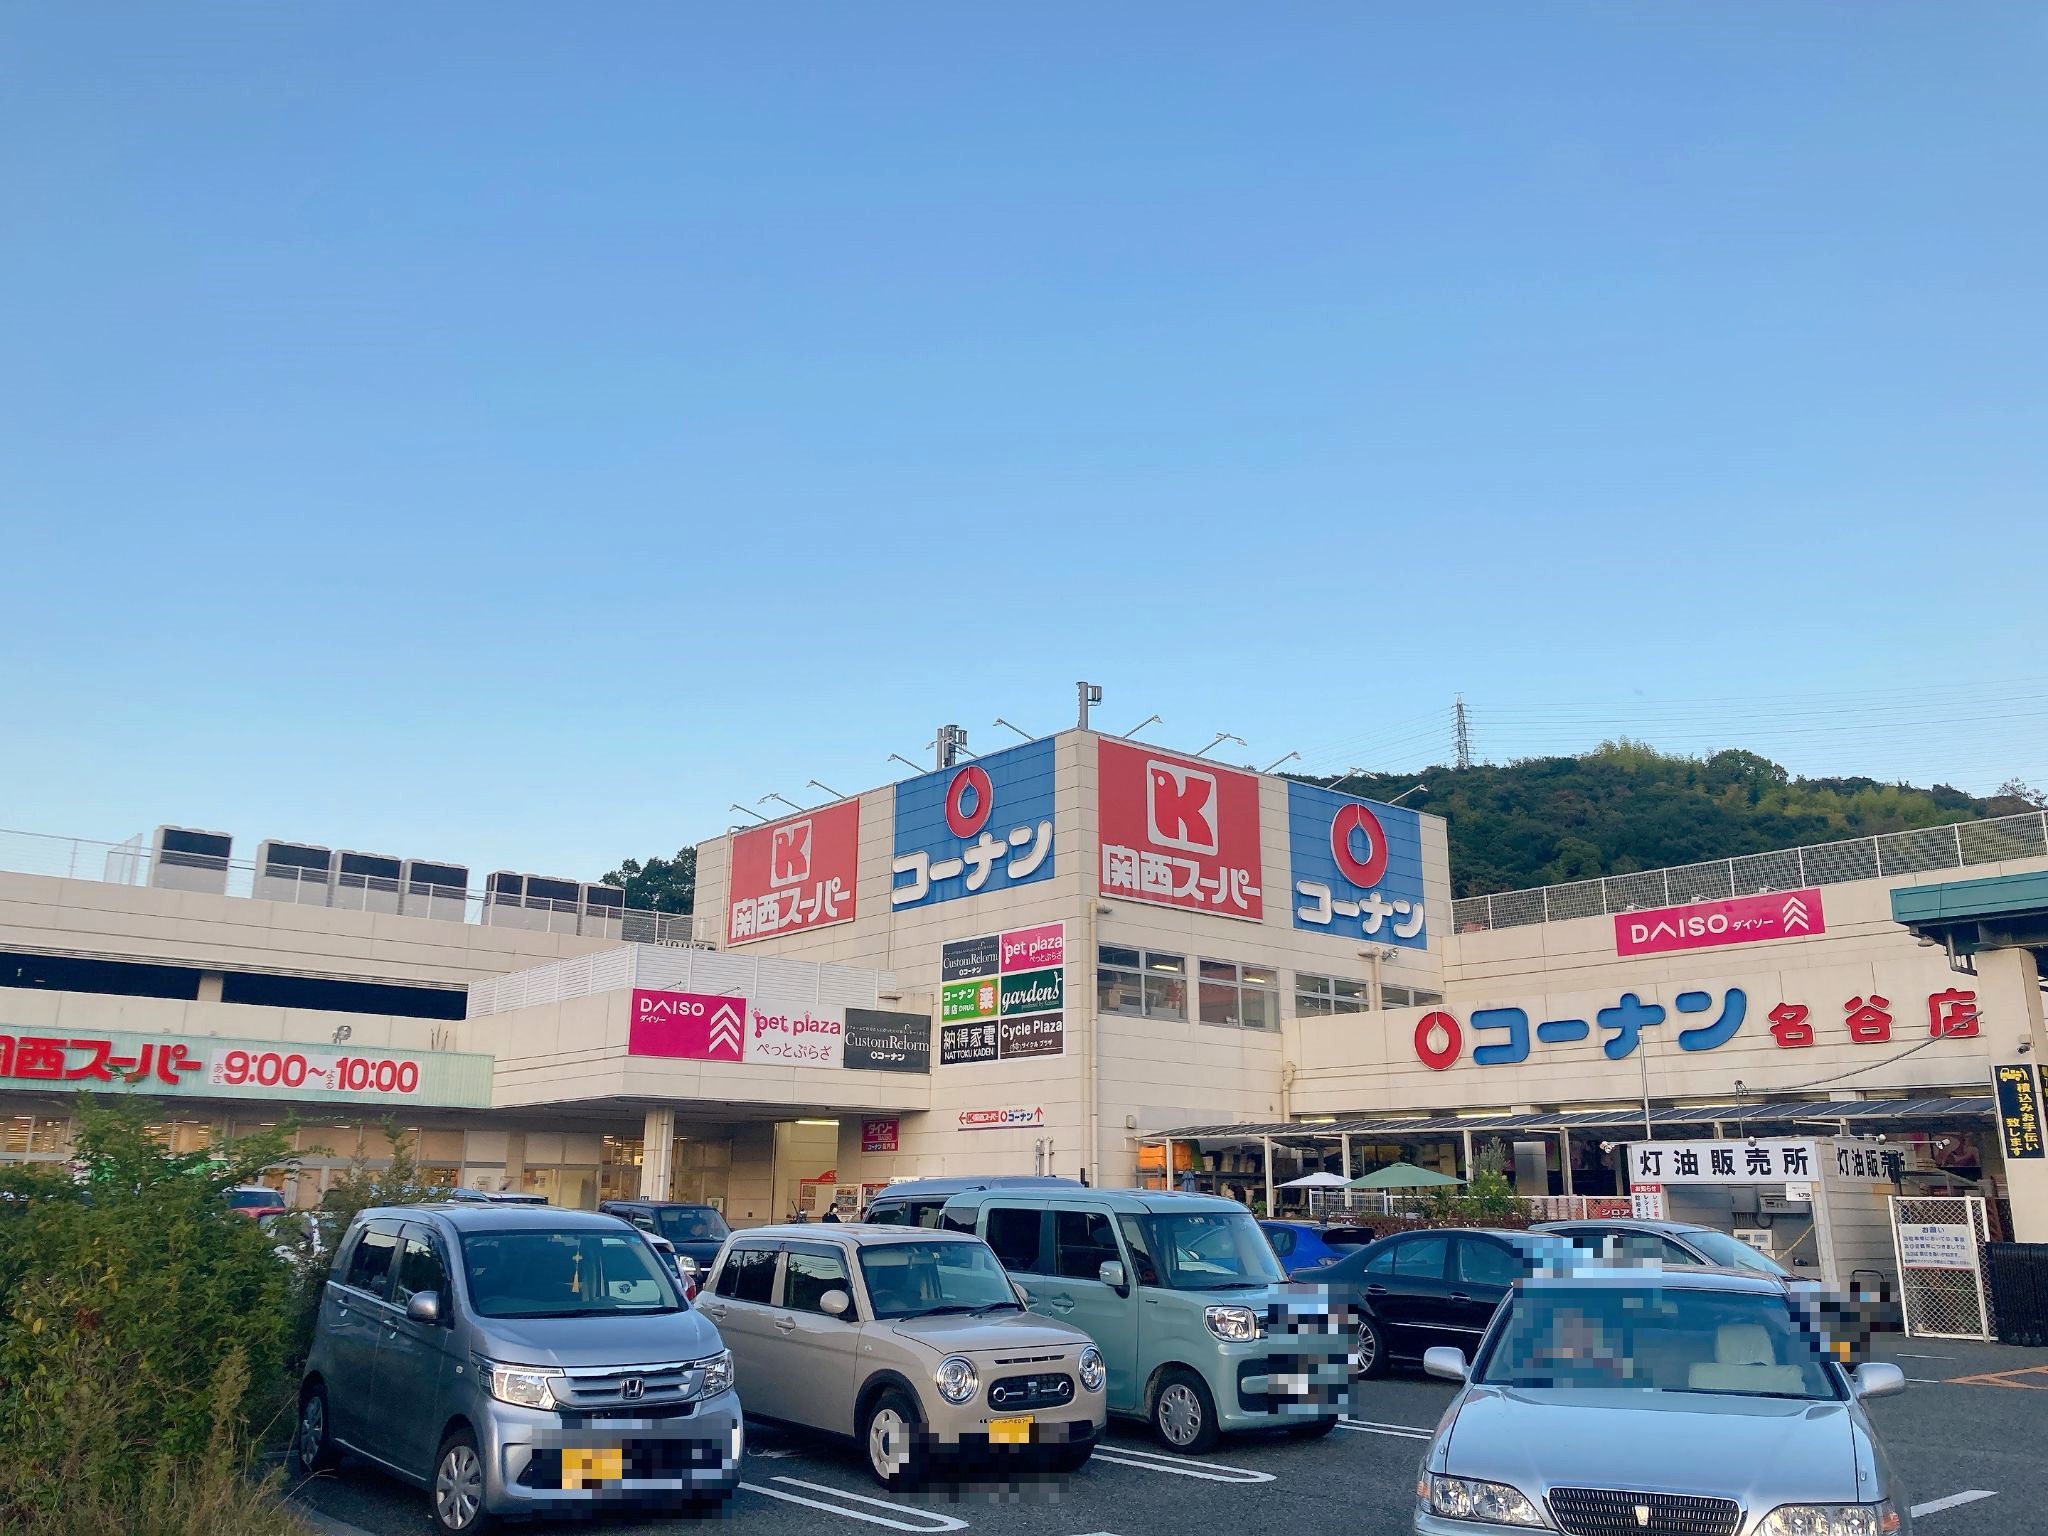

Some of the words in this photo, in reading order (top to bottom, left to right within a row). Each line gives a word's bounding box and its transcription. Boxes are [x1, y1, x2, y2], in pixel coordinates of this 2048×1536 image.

[892, 820, 1053, 905] コーナン
[1102, 843, 1261, 909] 関西スーパー
[731, 876, 850, 939] 関西スーパー
[1296, 880, 1424, 938] コーナン
[1631, 914, 1728, 944] DAISO
[1733, 918, 1774, 931] ダイソー
[1002, 941, 1027, 964] pet
[1029, 935, 1063, 956] plaza
[640, 999, 704, 1016] DAISO
[944, 989, 975, 1001] コーナン
[980, 987, 993, 1009] 薬
[639, 1015, 666, 1023] ダイソー
[753, 1012, 788, 1038] pet
[793, 1014, 840, 1036] plaza
[1002, 1022, 1031, 1040] Cycle
[1033, 1020, 1063, 1034] Plaza
[1470, 987, 1748, 1060] コーナン
[1767, 988, 1981, 1049] 名谷店
[944, 1025, 995, 1050] 納得家電
[756, 1043, 832, 1060] ぺっとぷらざ
[879, 1051, 905, 1061] コーナン
[944, 1049, 972, 1060] NATTOKU
[973, 1047, 994, 1058] KADEN
[1008, 1112, 1033, 1122] コーナン
[2016, 1083, 2039, 1151] 積込みお手伝い
[2006, 1118, 2023, 1156] 致します
[1640, 1147, 1809, 1176] 灯油販売所
